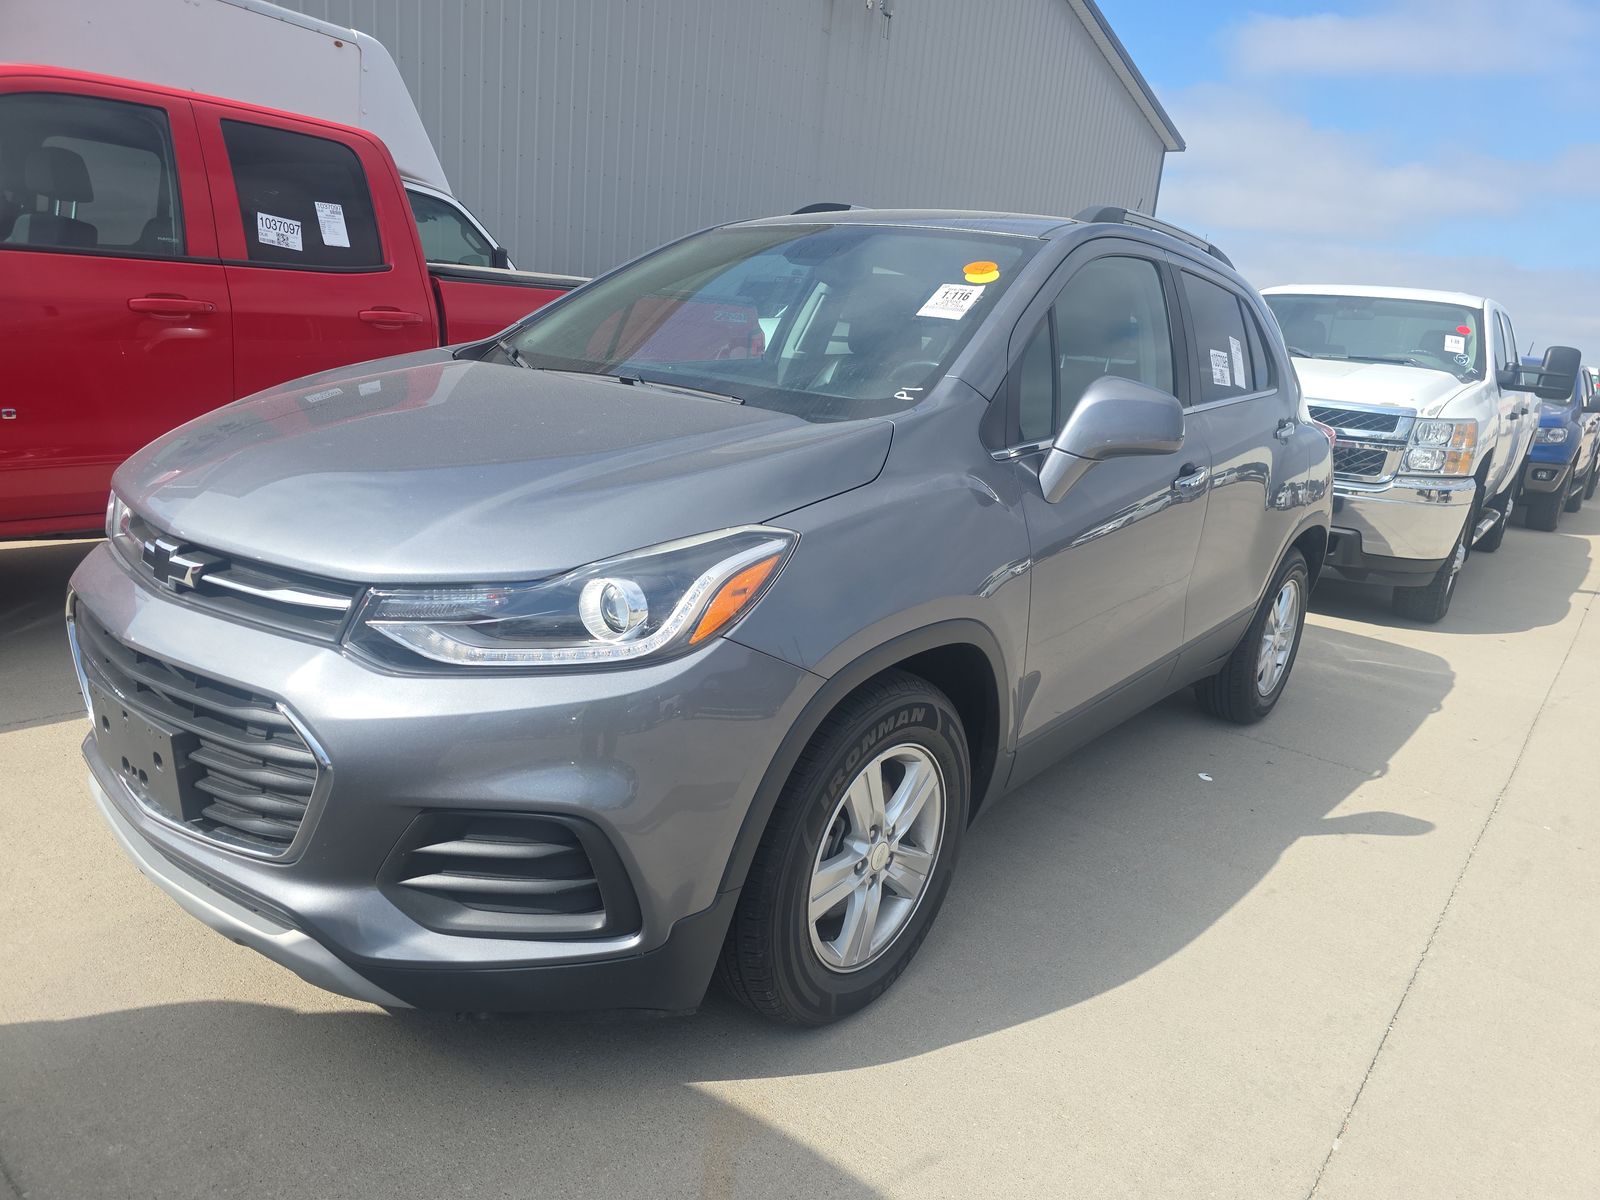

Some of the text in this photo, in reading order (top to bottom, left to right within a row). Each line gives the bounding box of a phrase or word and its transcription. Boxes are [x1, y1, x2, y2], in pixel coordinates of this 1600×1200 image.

[260, 216, 300, 236] 1037097
[942, 290, 972, 301] 1:116
[820, 707, 926, 811] IRONMAN
